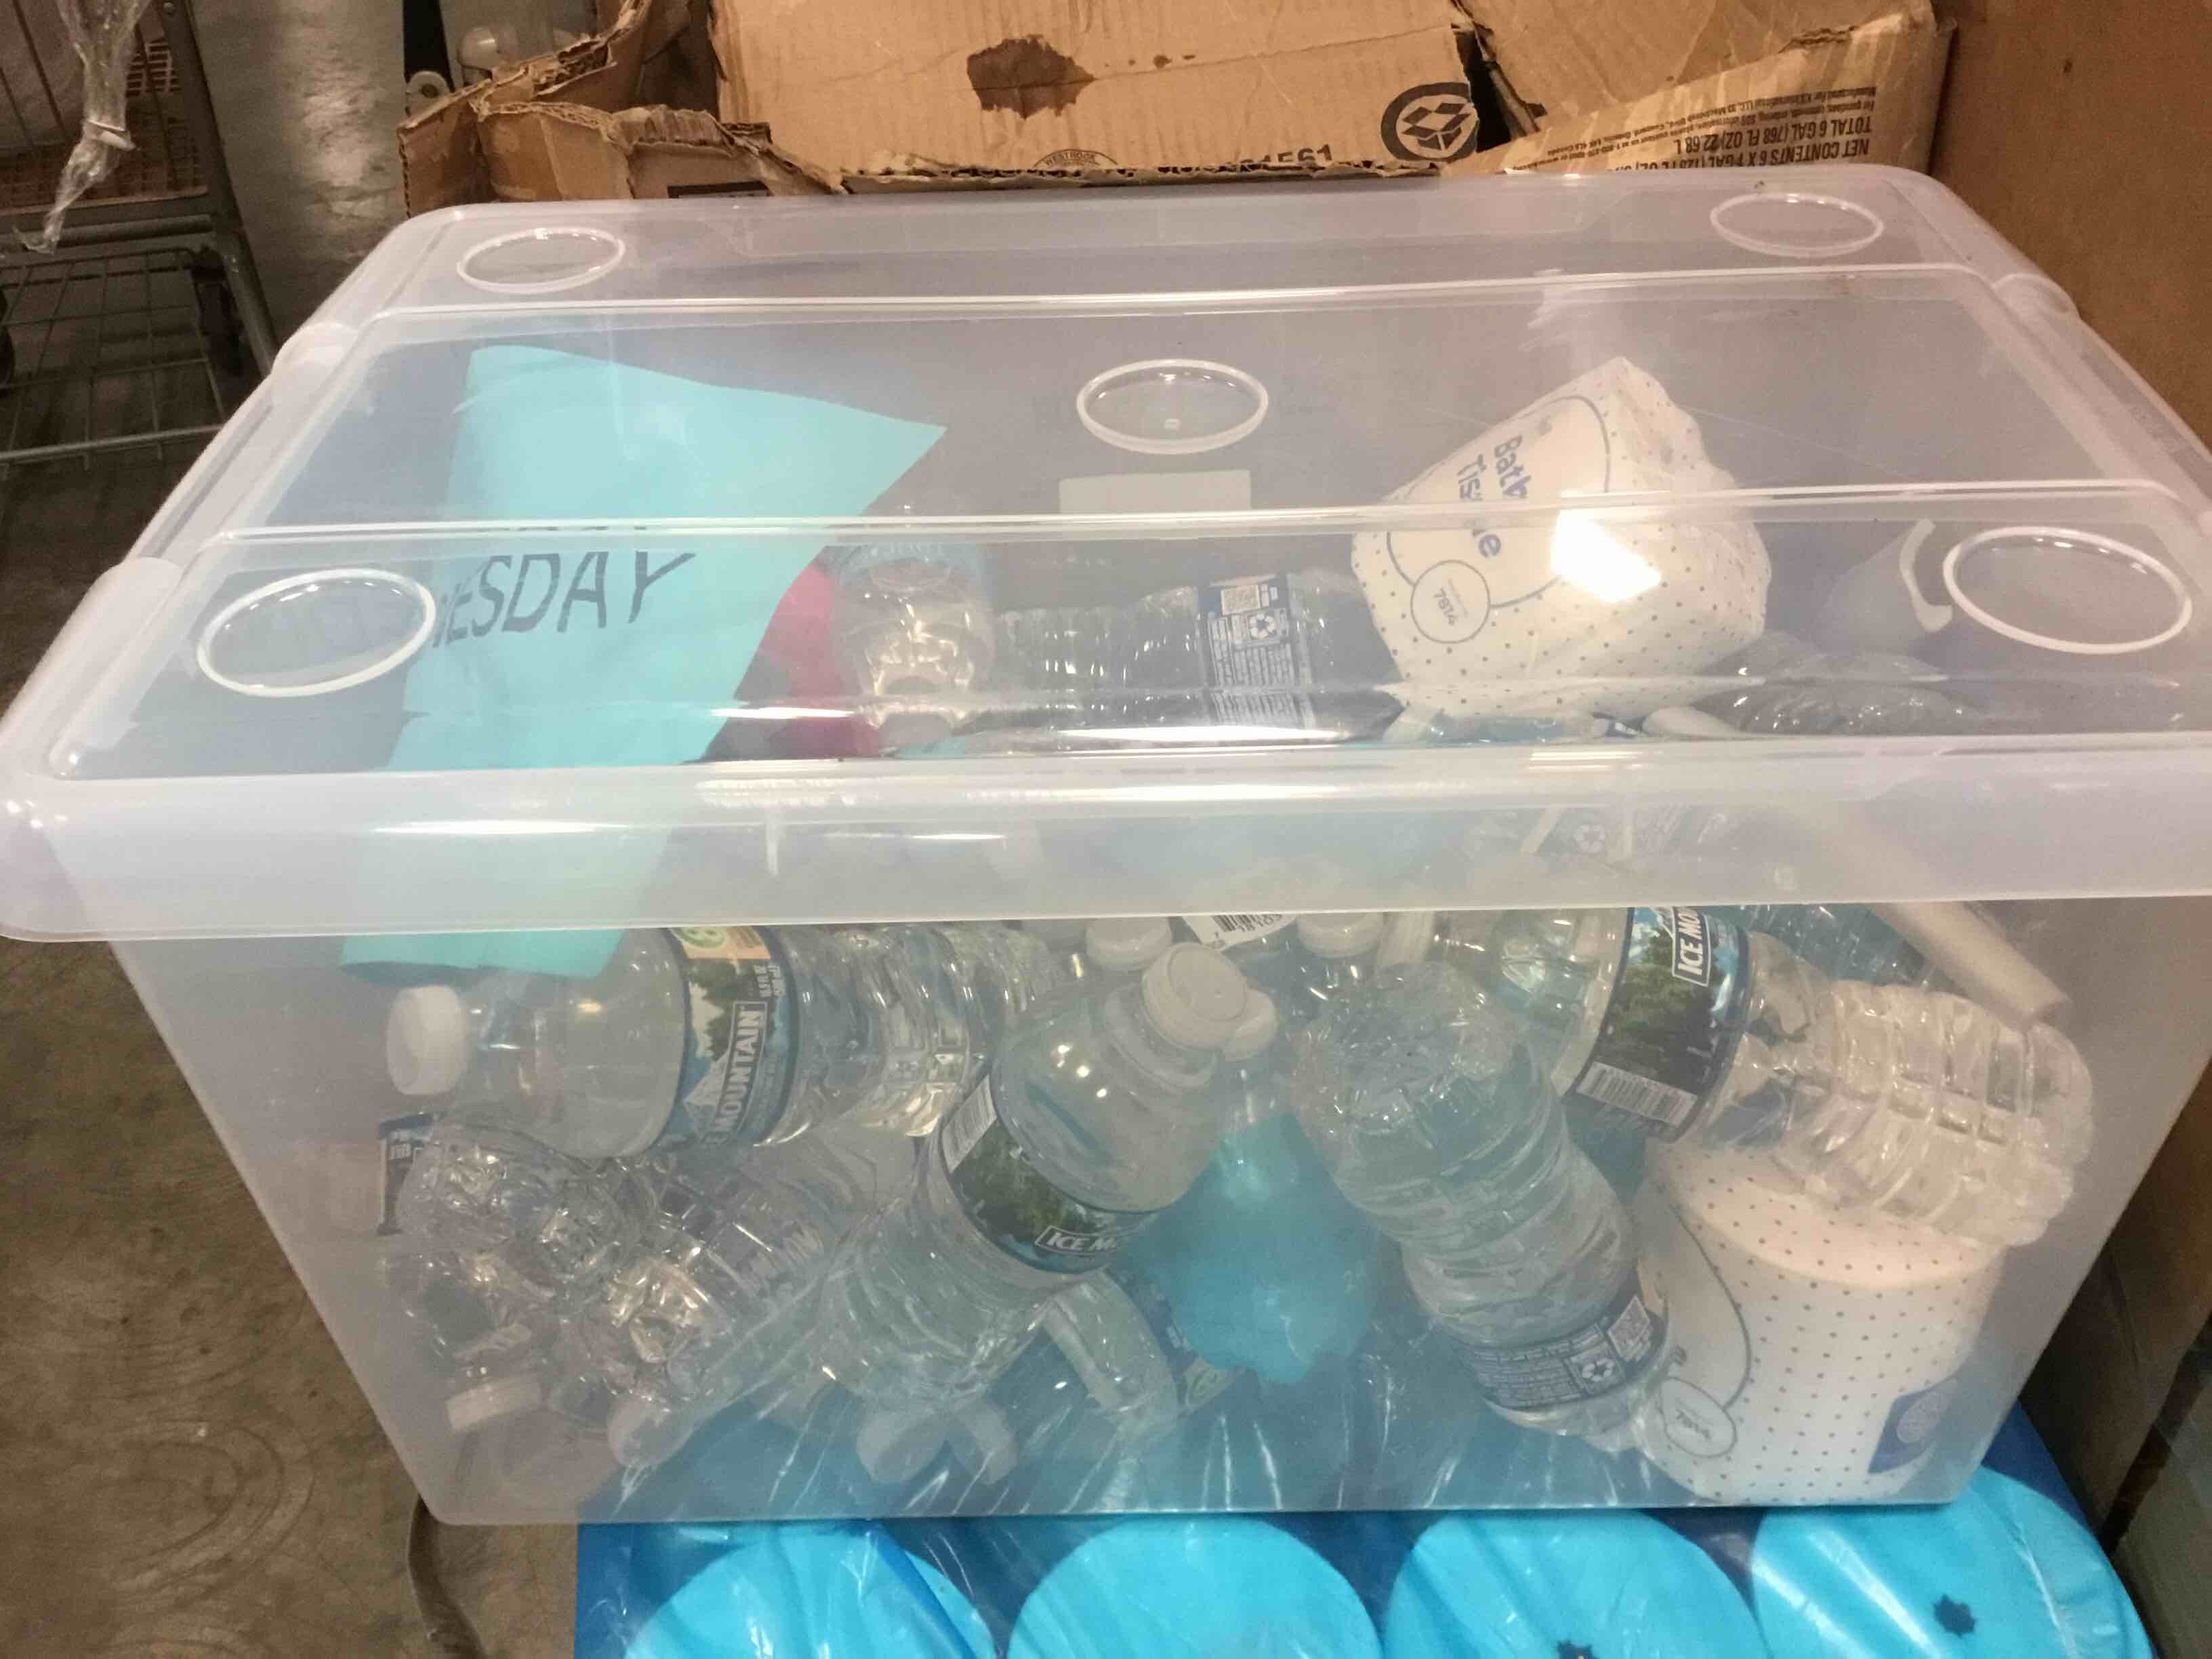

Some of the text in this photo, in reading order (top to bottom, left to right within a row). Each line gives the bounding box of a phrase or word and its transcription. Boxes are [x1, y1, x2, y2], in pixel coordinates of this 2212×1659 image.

[1763, 123, 1788, 144] (768
[1791, 121, 1817, 140] GAL
[1820, 120, 1828, 138] 6
[1831, 116, 1872, 137] TOTAL
[1673, 139, 1681, 155] L
[1746, 129, 1760, 146] FL
[1771, 141, 1840, 165] CONTENTS
[1842, 138, 1870, 158] NET
[1747, 151, 1757, 167] X
[1759, 150, 1767, 167] 6
[1676, 909, 1704, 977] ICE MO
[714, 1008, 763, 1134] MOUNTAIN
[1047, 1232, 1087, 1250] ICE
